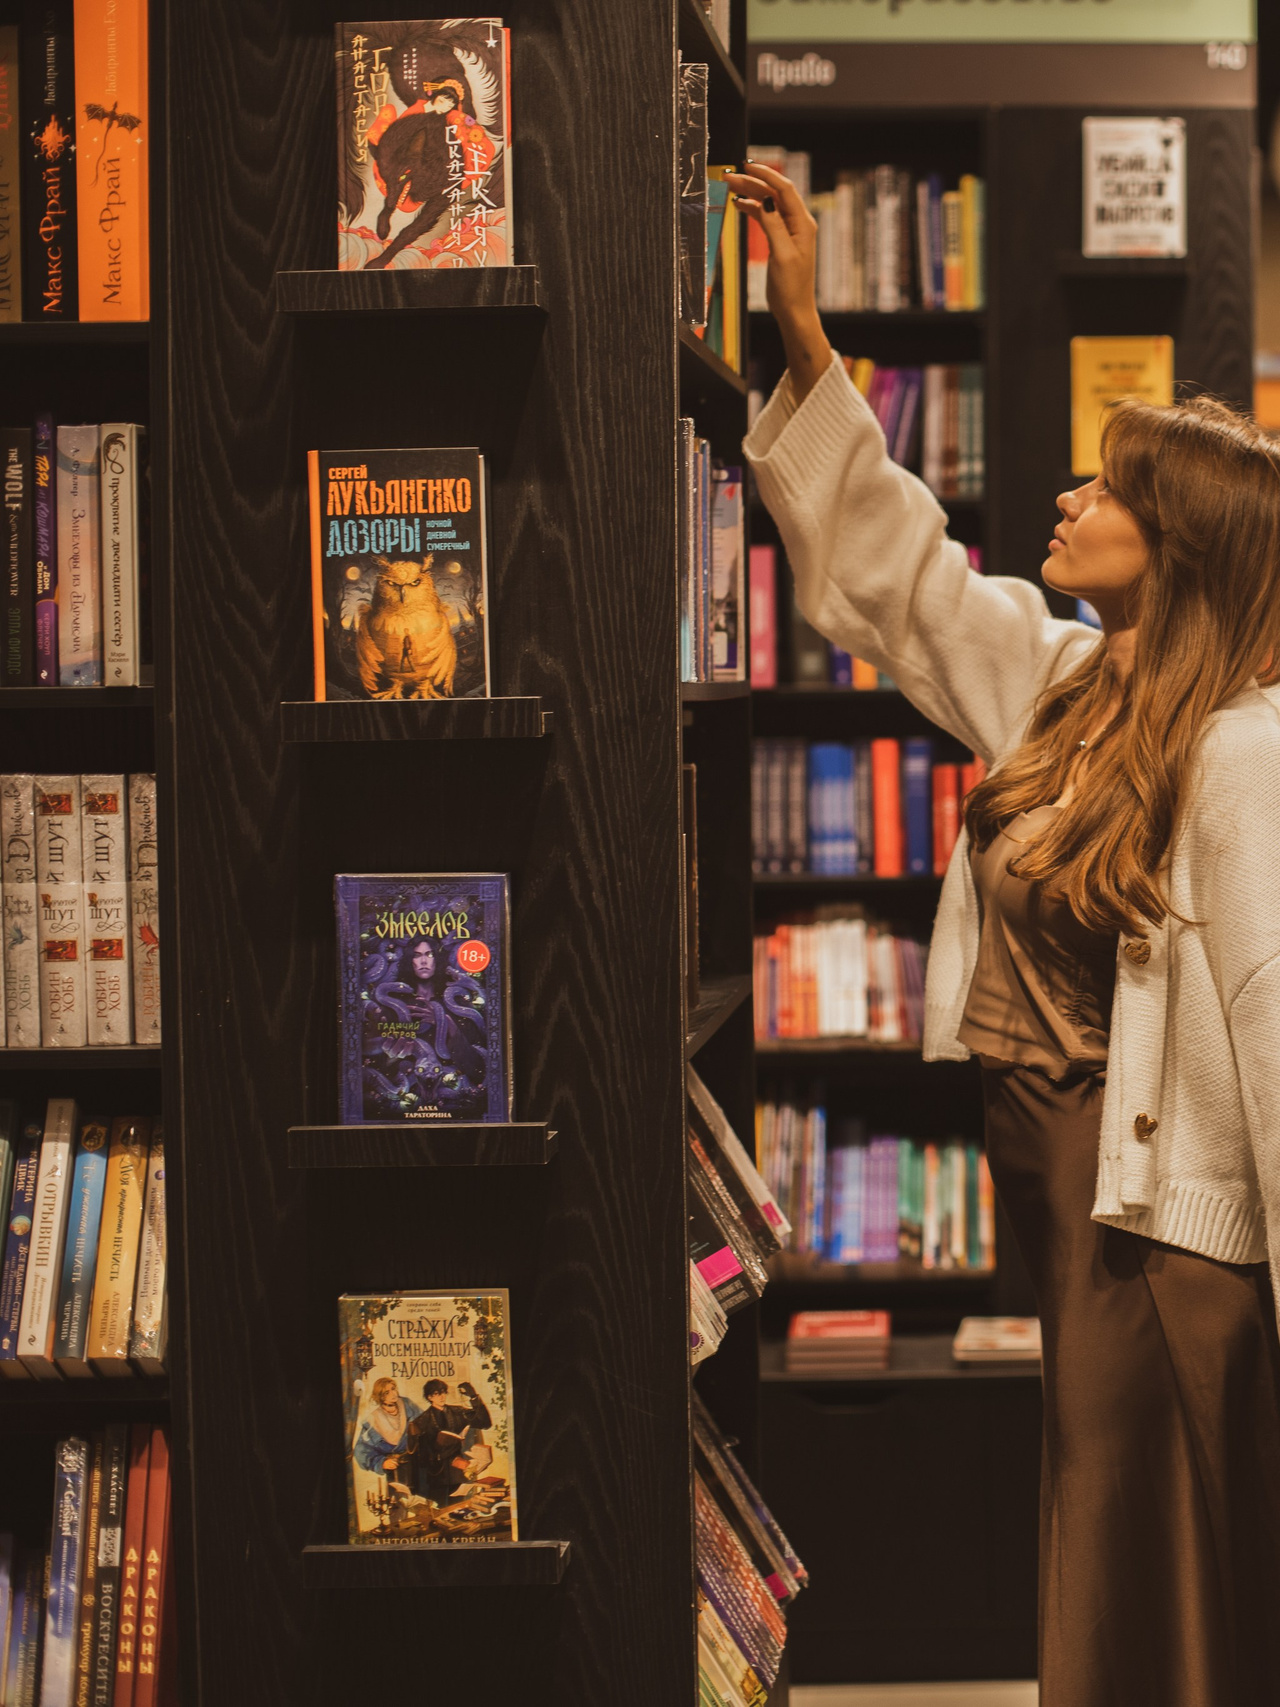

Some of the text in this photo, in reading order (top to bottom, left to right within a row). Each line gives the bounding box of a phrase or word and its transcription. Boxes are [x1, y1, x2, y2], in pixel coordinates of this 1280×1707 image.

[39, 167, 66, 313] Макс Фрай
[98, 157, 126, 305] Макс Фрай
[8, 448, 18, 462] THE
[328, 464, 368, 480] СЕРГЕЙ
[4, 464, 23, 511] WOLF
[326, 477, 472, 516] ЛУКЬЯНЕНКО
[326, 517, 421, 558] ДОЗОРЫ
[425, 518, 453, 528] НОЧНОЙ
[426, 529, 457, 541] ДНЕВНОЙ
[426, 540, 471, 551] СУМЕРЕЧНЫЙ
[462, 949, 486, 963] 18+
[49, 971, 61, 1020] РОБИН
[62, 976, 75, 1013] ХОББ
[95, 970, 108, 1019] РОБИН
[108, 975, 121, 1011] ХОББ
[34, 1181, 58, 1268] ОТРЫВКИН
[67, 1291, 83, 1348] АЛЕКСАНДРА
[388, 1315, 460, 1341] СТРАЖИ
[374, 1341, 474, 1358] ВОСЕМНАДЦАТИ
[391, 1358, 455, 1379] РАЙОНОВ
[117, 1547, 138, 1673] ДРАКОНЫ
[139, 1547, 159, 1674] ДРАКОНЫ
[94, 1583, 112, 1707] ВОСКРЕСИТЕ
